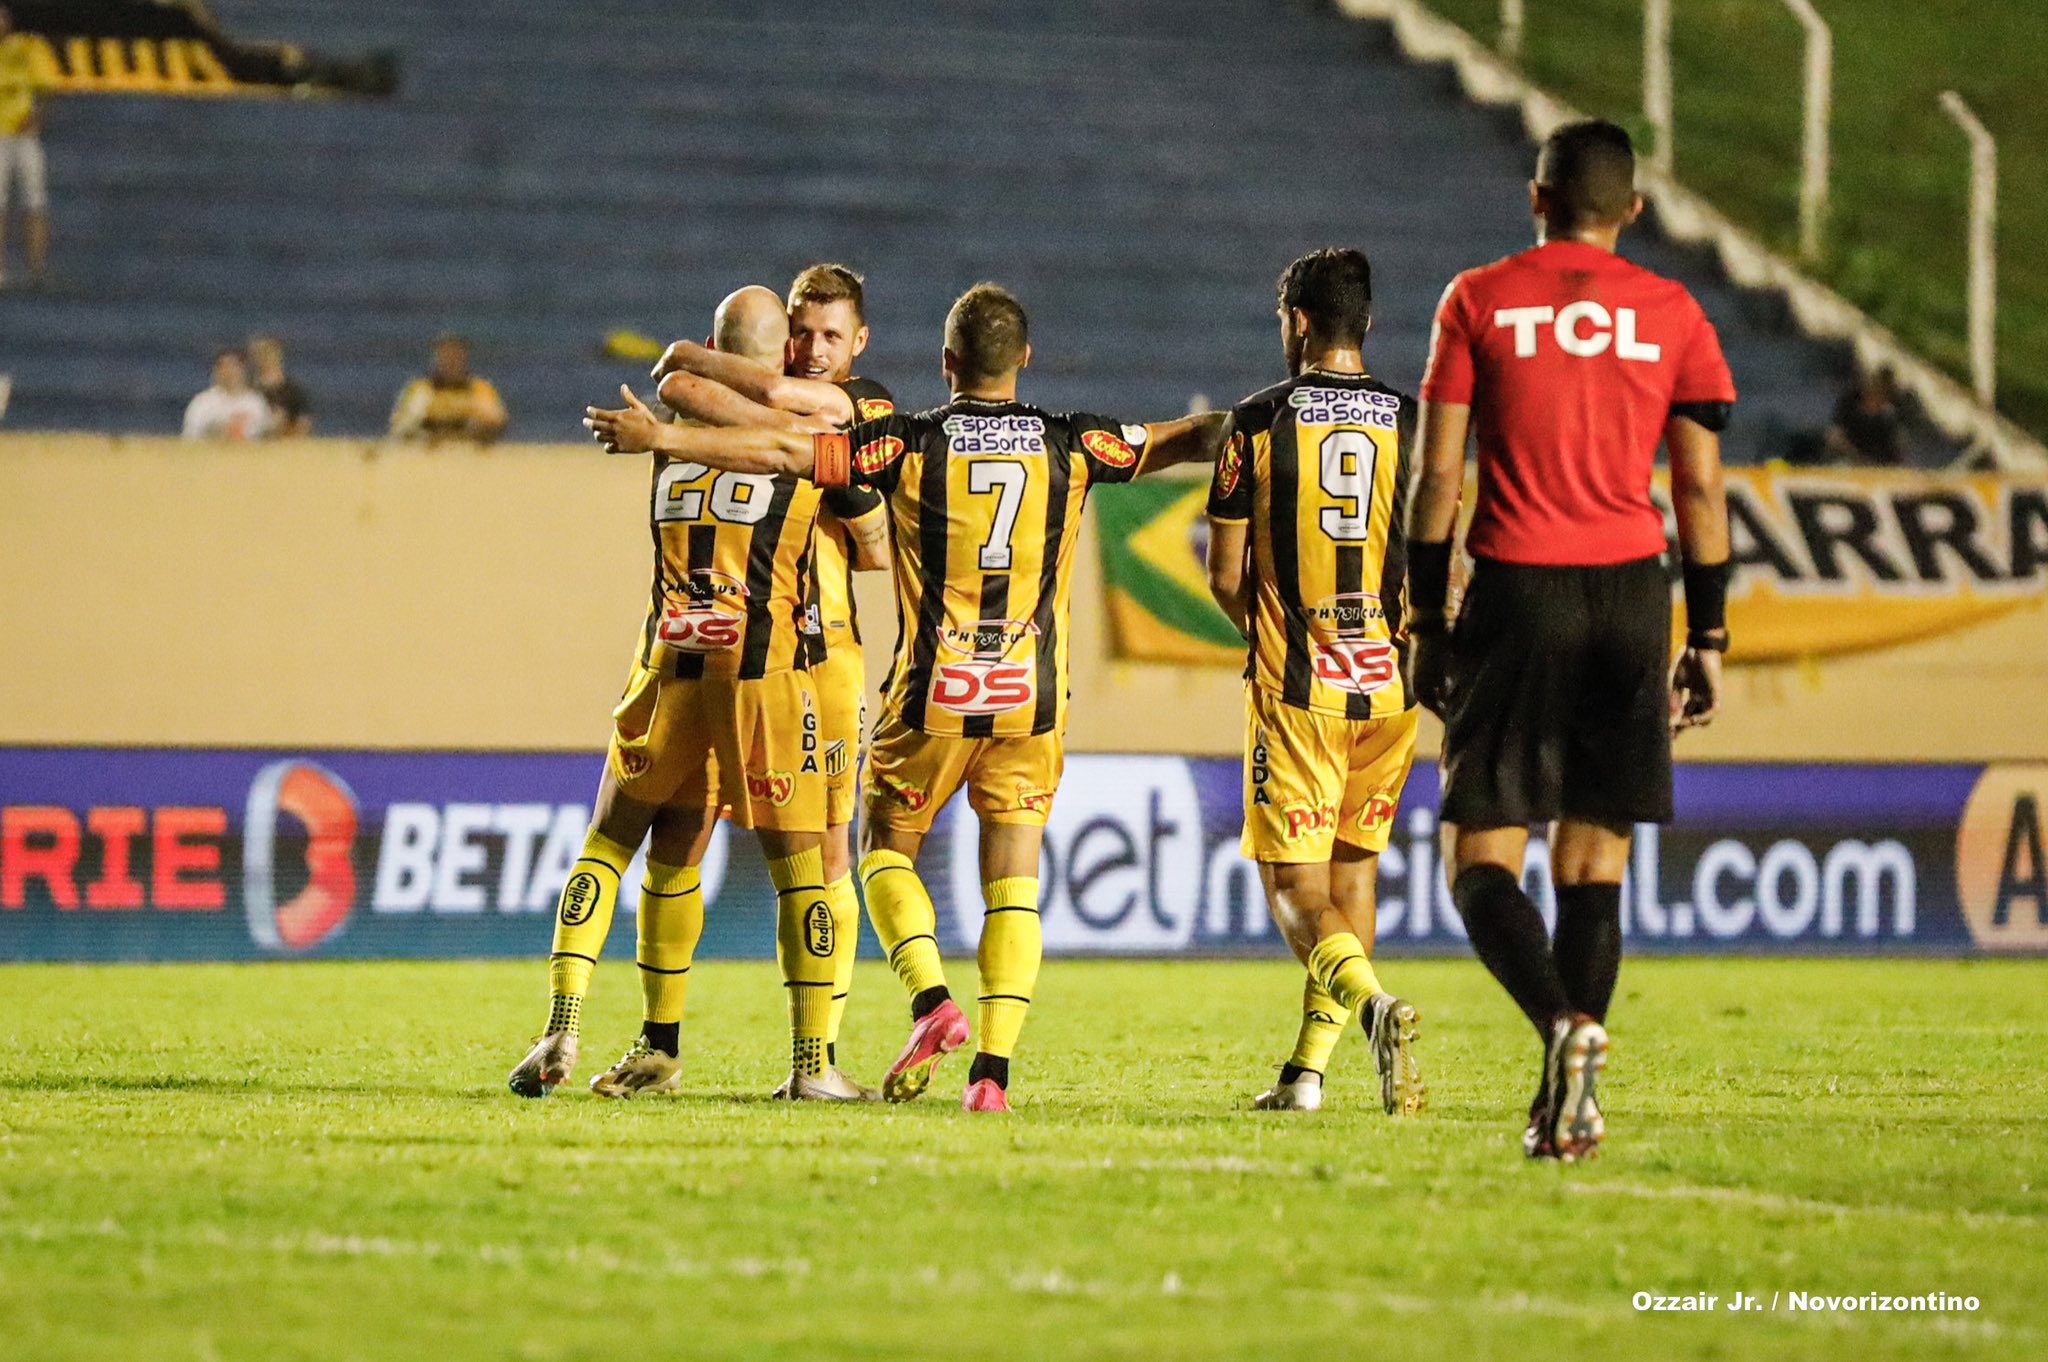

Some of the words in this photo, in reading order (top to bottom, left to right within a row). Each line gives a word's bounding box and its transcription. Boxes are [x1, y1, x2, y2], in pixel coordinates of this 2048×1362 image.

[1493, 300, 1661, 363] TCL
[1291, 387, 1399, 409] Esportes
[945, 417, 1042, 435] Esportes
[1319, 430, 1377, 541] 9
[968, 460, 1028, 570] 7
[659, 608, 742, 646] DS
[1308, 607, 1386, 621] PHYSICUS
[1315, 644, 1394, 685] DS
[932, 667, 1031, 705] DS
[2, 805, 228, 911] RIE
[564, 876, 592, 920] Kodilar
[812, 905, 831, 951] Kodilar
